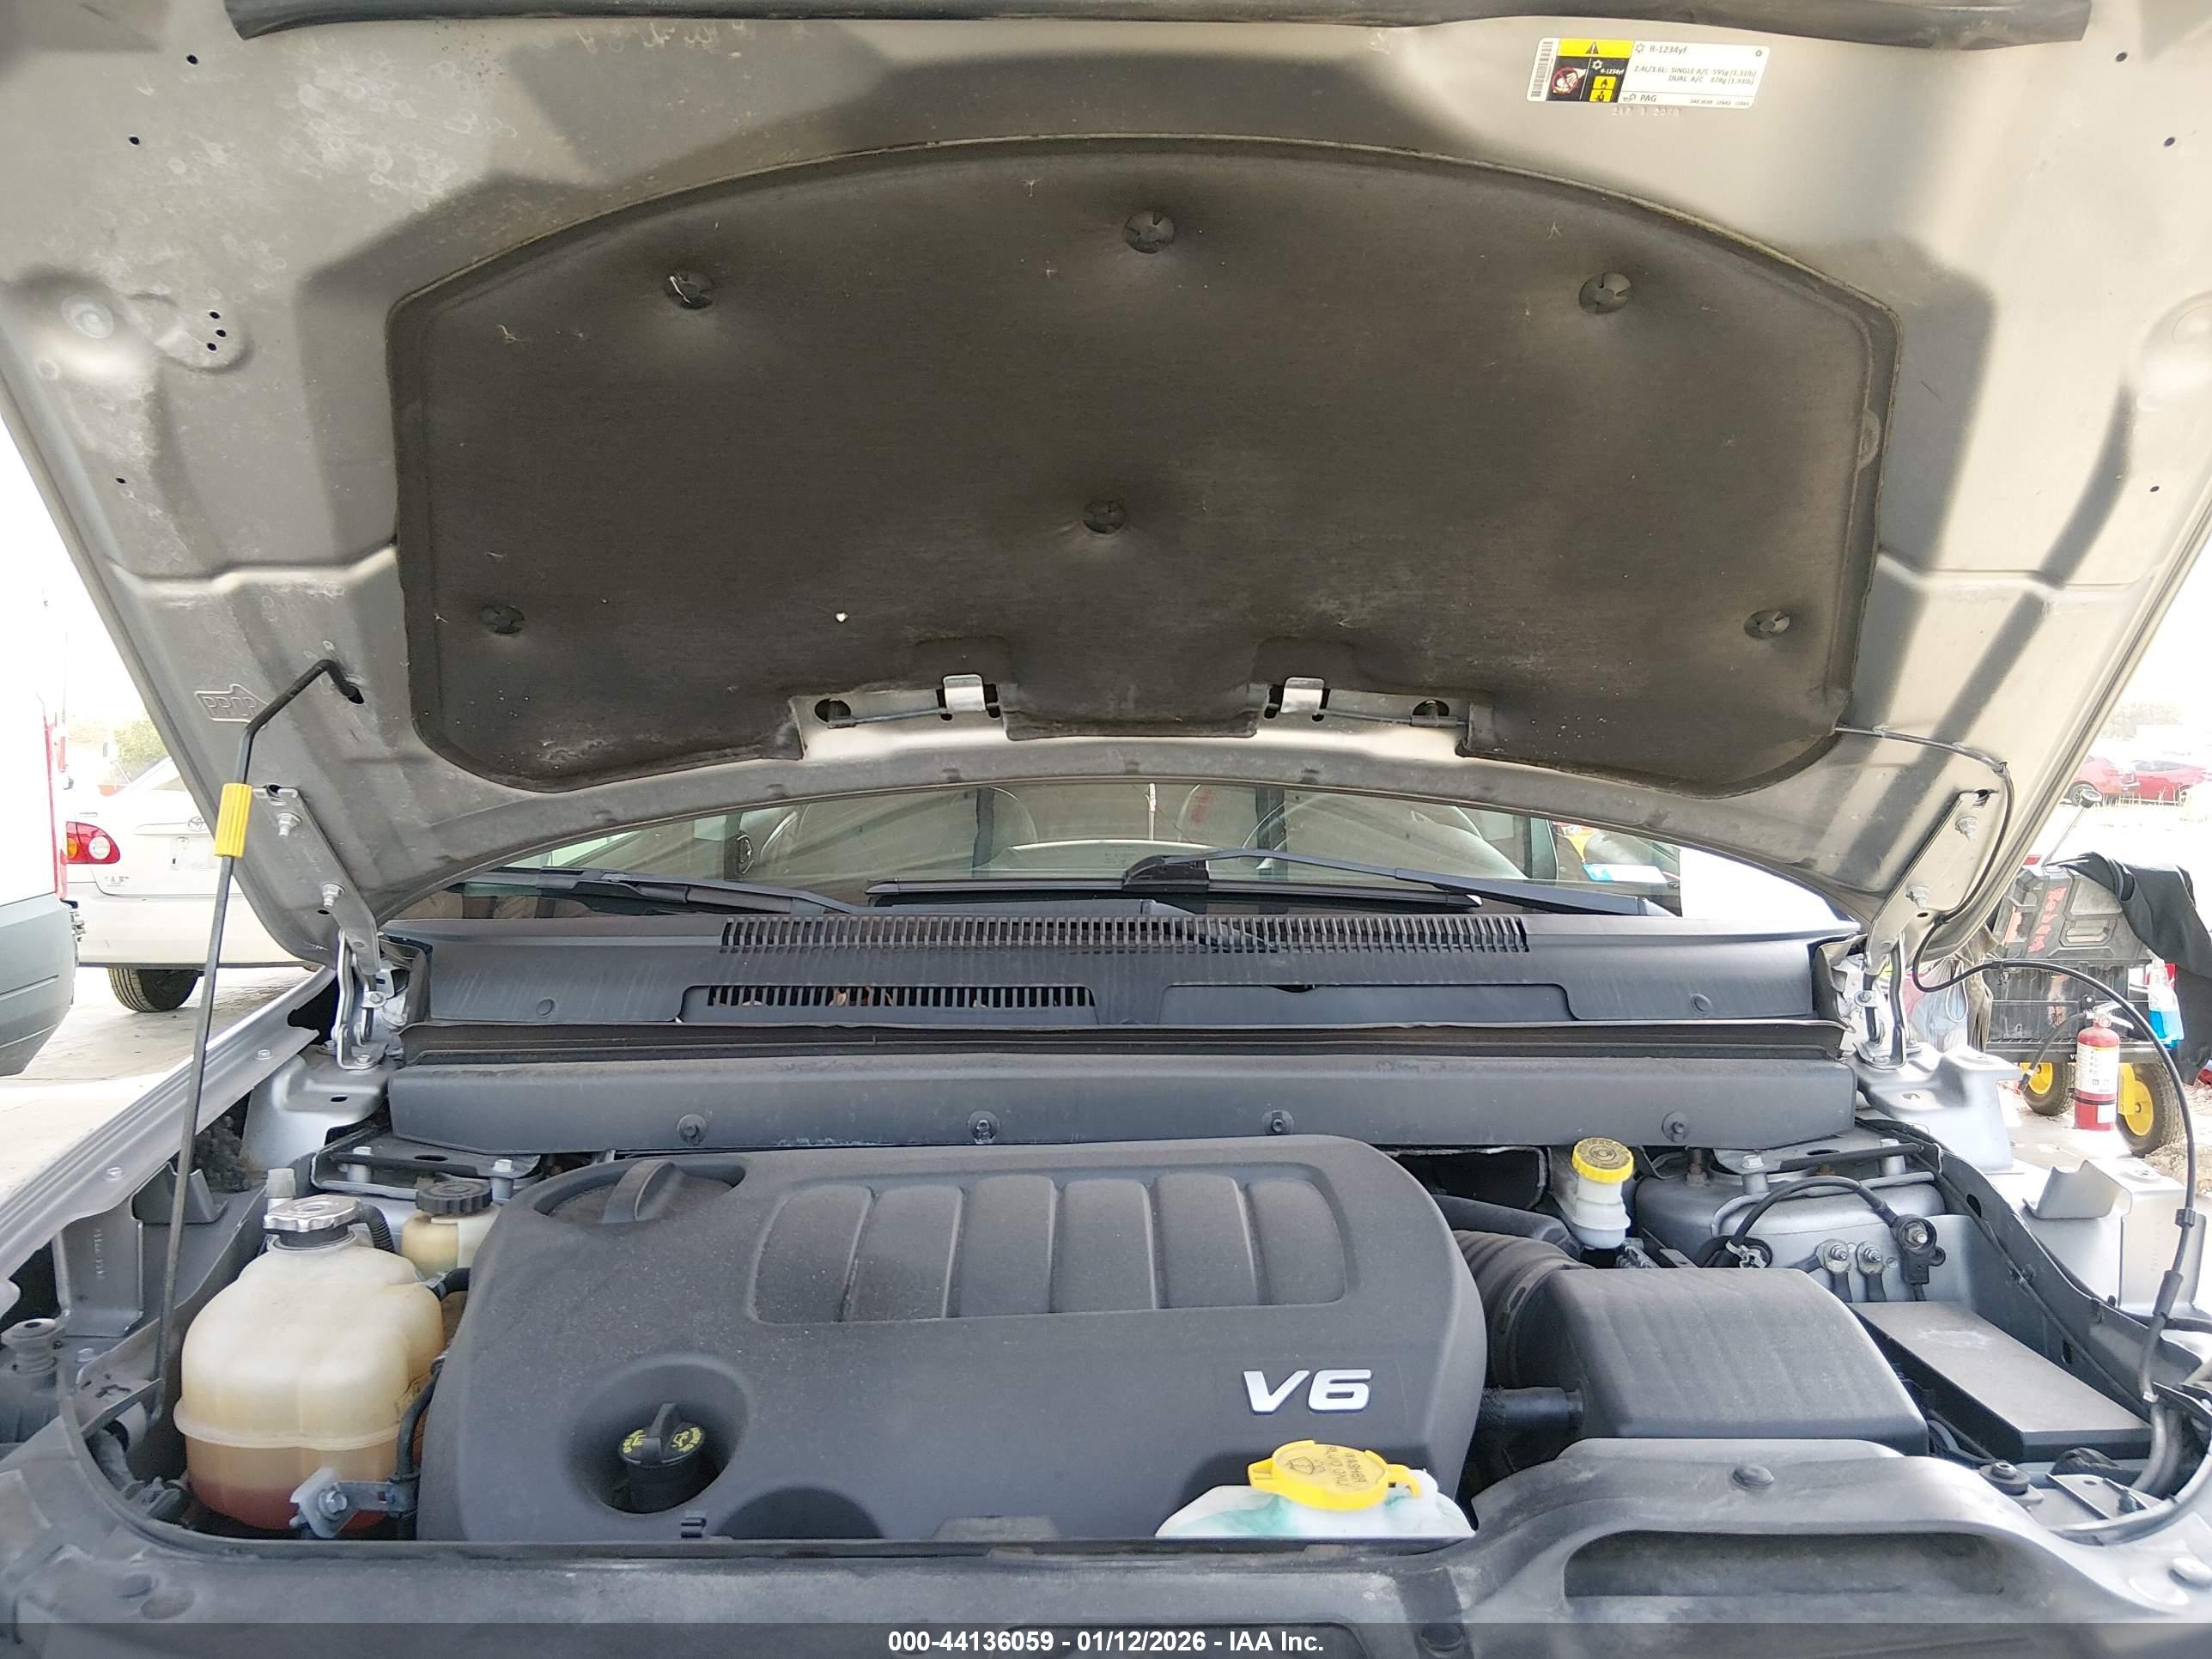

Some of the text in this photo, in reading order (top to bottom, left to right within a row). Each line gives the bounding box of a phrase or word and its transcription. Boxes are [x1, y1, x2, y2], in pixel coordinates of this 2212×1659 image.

[1650, 46, 1687, 55] R-1234yf
[201, 696, 258, 716] PROP
[1243, 1369, 1371, 1414] V6
[1345, 1452, 1367, 1483] WASHER
